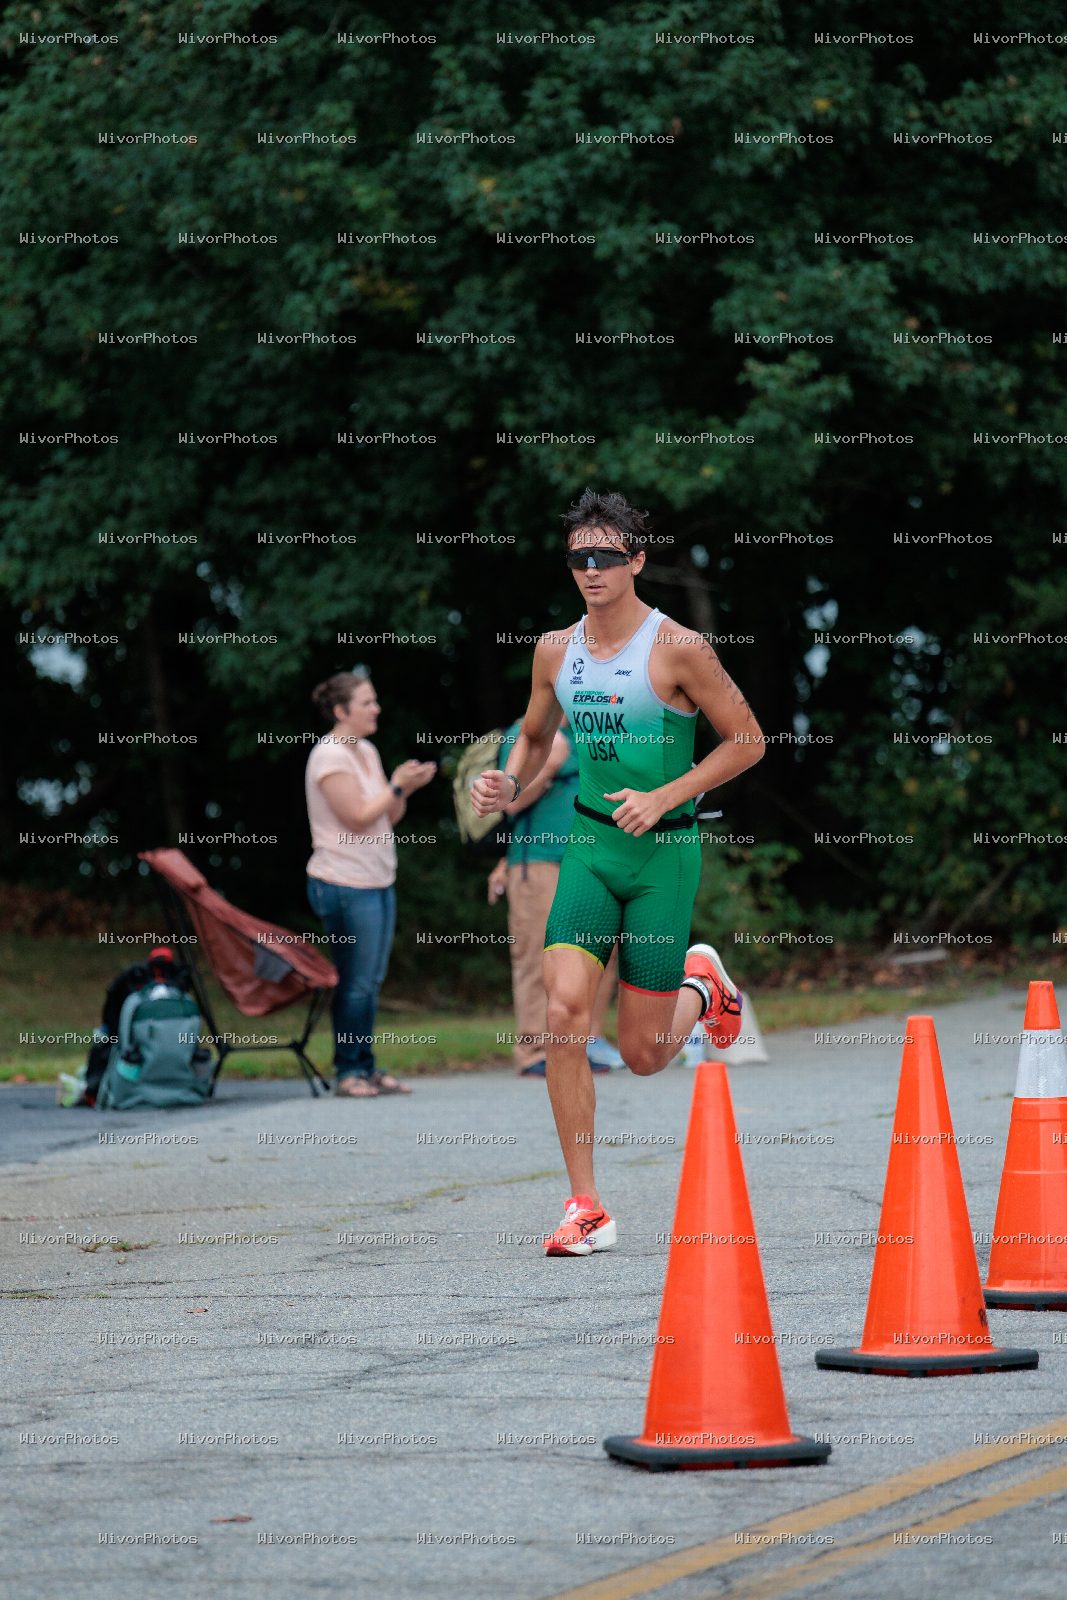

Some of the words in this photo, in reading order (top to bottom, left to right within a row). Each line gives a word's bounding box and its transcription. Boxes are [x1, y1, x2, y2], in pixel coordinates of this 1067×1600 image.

[573, 694, 624, 704] EXPLOSION
[573, 711, 628, 734] KOVAK
[588, 740, 620, 762] USA
